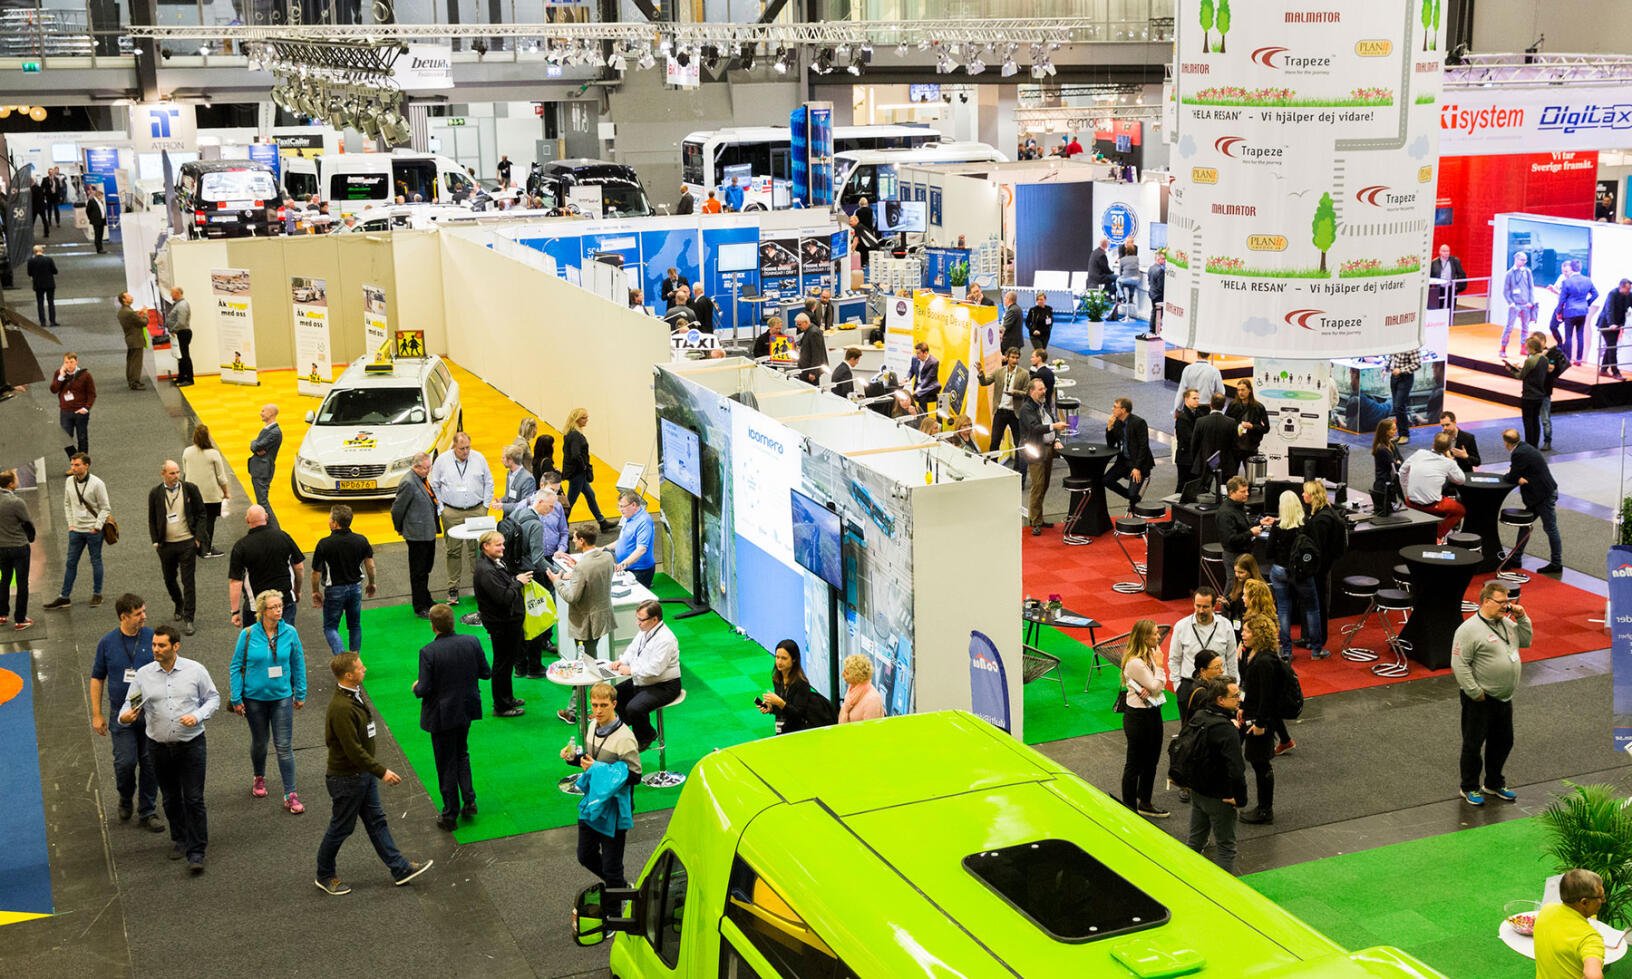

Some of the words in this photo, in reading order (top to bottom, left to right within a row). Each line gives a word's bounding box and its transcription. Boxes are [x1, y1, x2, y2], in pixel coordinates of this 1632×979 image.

[1284, 12, 1341, 23] MALMATOR
[1284, 55, 1331, 68] Trapeze
[1214, 110, 1242, 121] RESAN'
[1261, 112, 1271, 121] Vi
[1276, 111, 1314, 124] hjälper
[1318, 111, 1335, 124] dej
[1339, 111, 1374, 122] vidare!
[151, 141, 185, 150] ATRON
[1241, 146, 1283, 158] Trapeze
[1385, 193, 1416, 205] Trapeze
[1211, 203, 1257, 216] MALMATOR
[1220, 279, 1247, 291] 'HELA
[1251, 282, 1288, 292] RESAN'
[1310, 283, 1321, 293] Vi
[1325, 283, 1360, 295] hjälper
[1363, 281, 1377, 293] dej
[1320, 318, 1362, 330] Trapeze
[671, 338, 715, 348] TAXI
[748, 426, 784, 455] icomera
